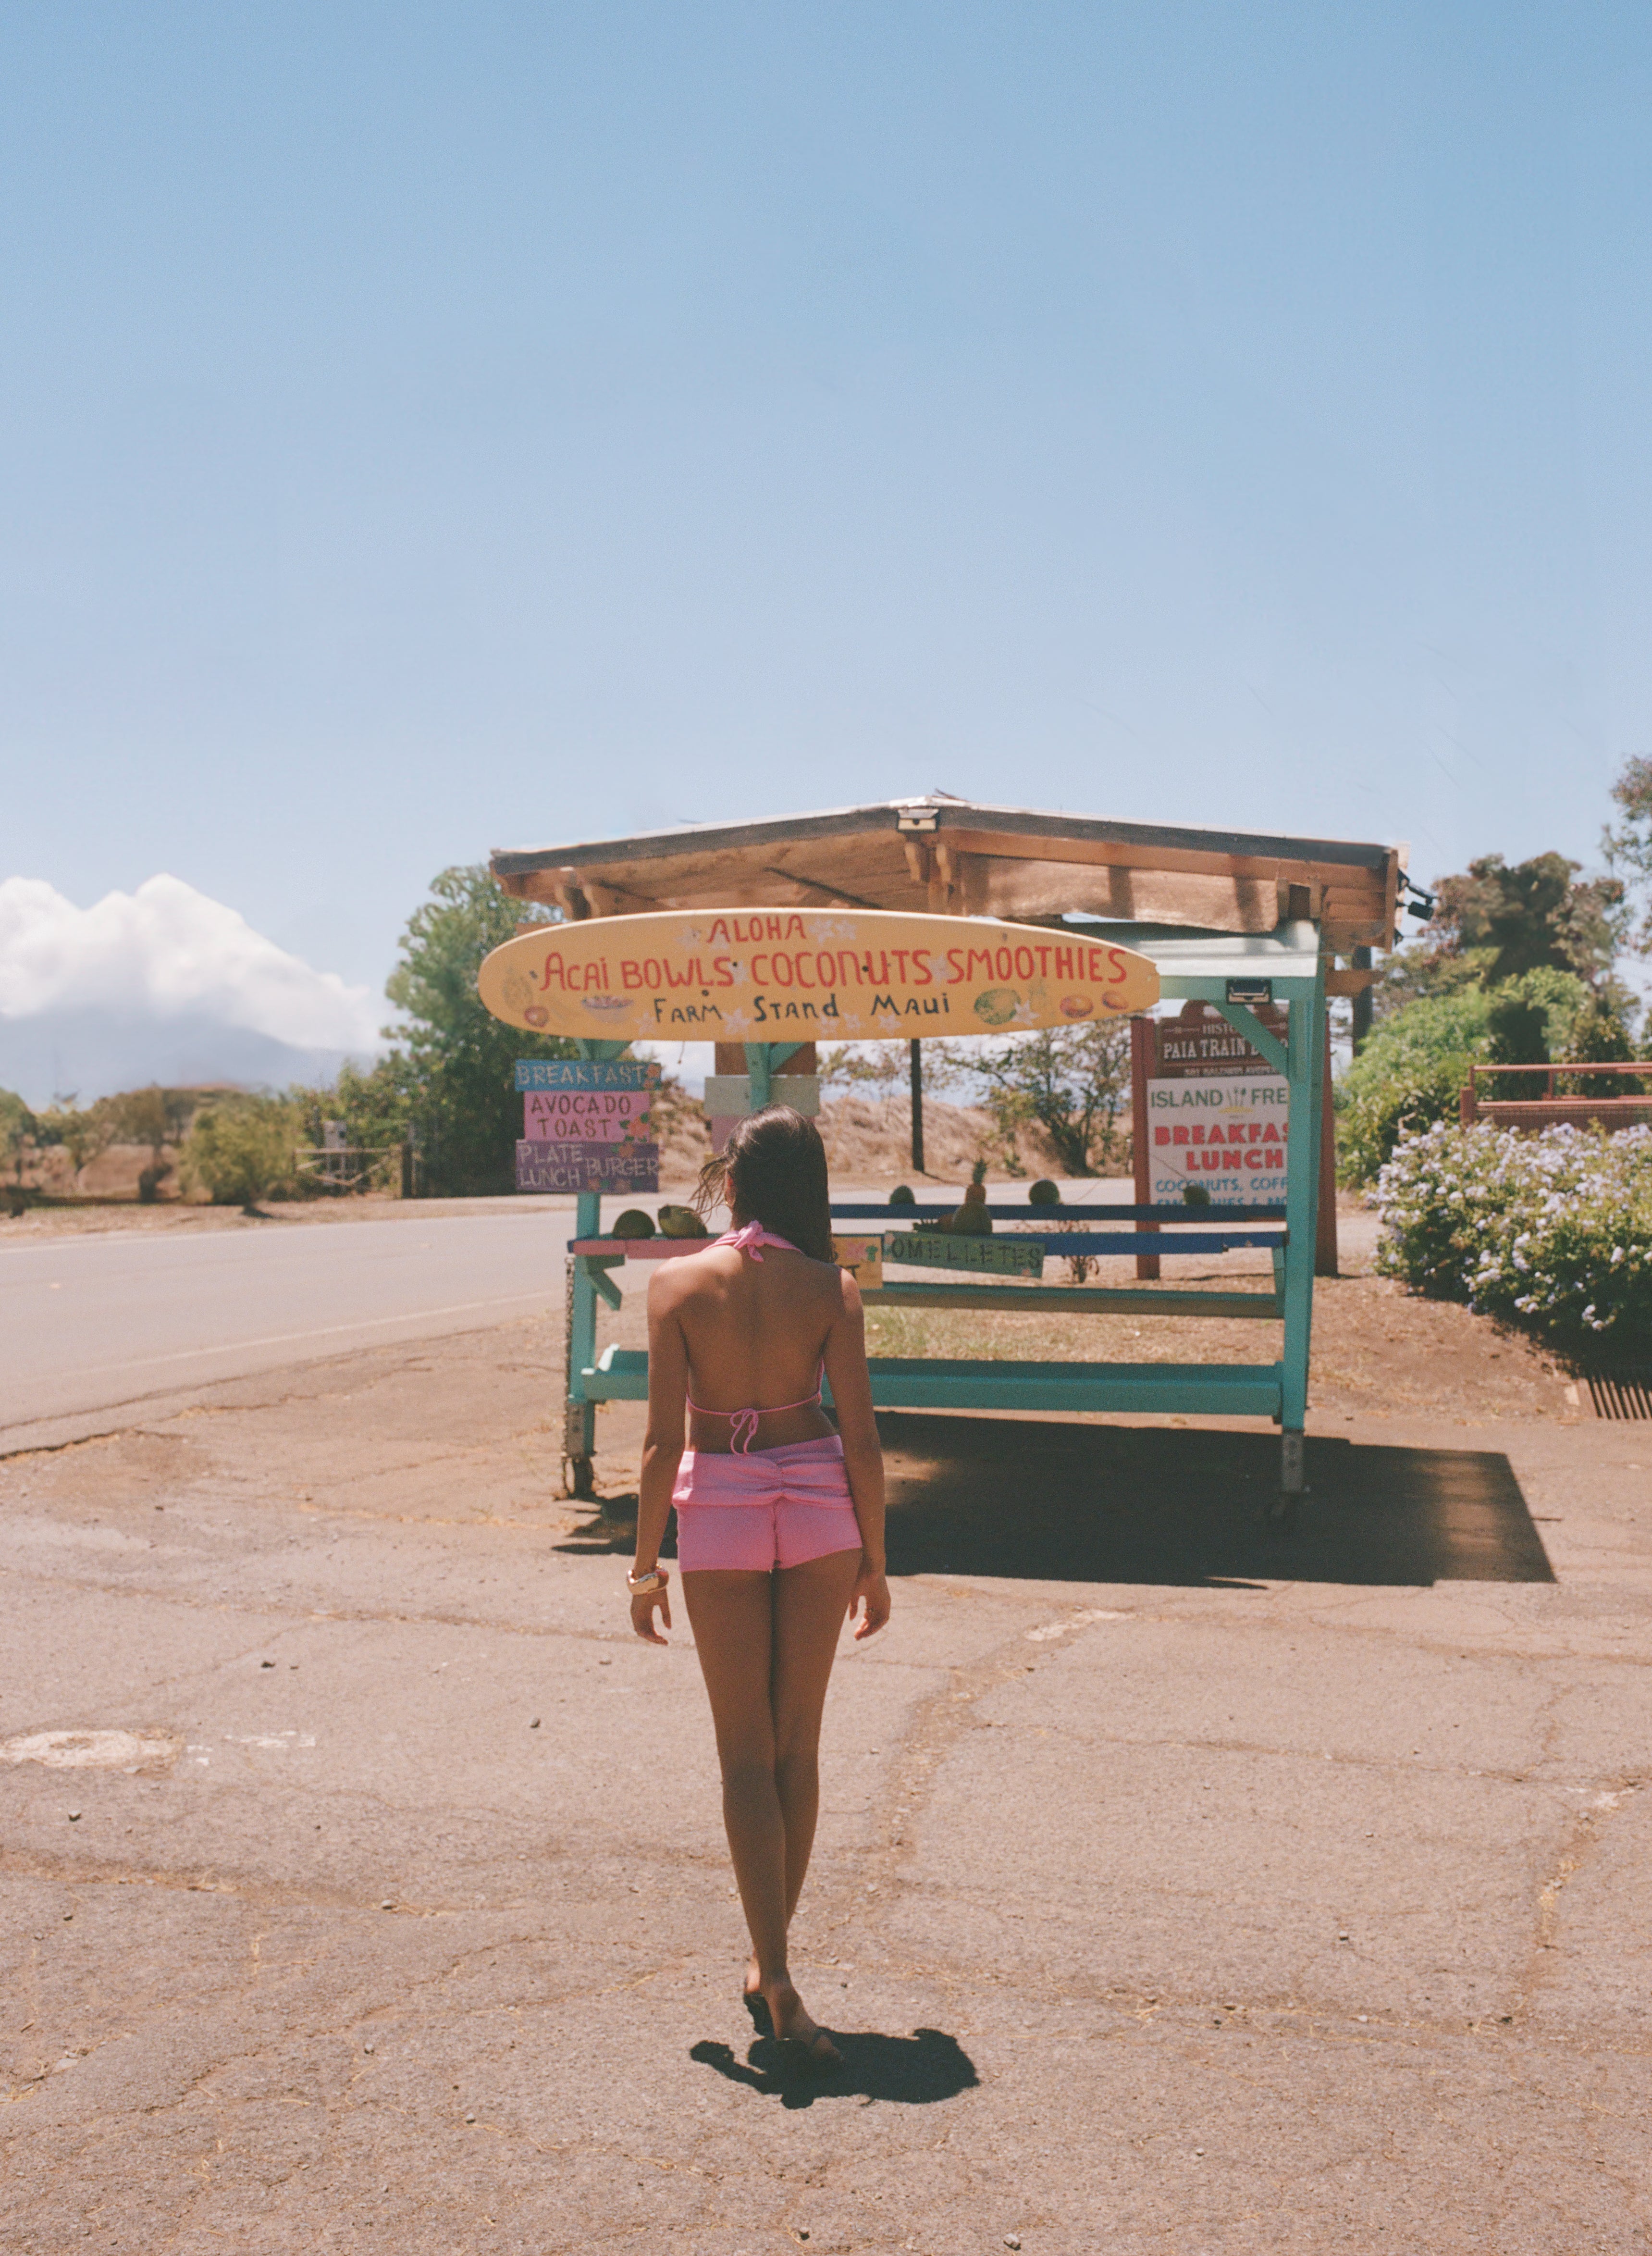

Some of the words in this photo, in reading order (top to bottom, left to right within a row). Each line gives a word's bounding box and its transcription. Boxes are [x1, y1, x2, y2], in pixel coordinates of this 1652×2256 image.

[707, 915, 807, 942] ALOHA
[621, 957, 734, 990] BOWLS
[751, 949, 933, 988] COCONUTS
[947, 946, 1127, 985] SMOOTHIES
[1163, 1041, 1197, 1059] PAIA
[1200, 1037, 1246, 1057] TRAIN
[516, 1065, 644, 1085] BREAKFAST
[531, 1094, 631, 1115] AVOCADO
[1151, 1089, 1223, 1107] ISLAND
[536, 1118, 610, 1138] TOAST
[517, 1144, 583, 1164] PLATE
[1186, 1149, 1283, 1171] LUNCH
[586, 1157, 660, 1177] BURGER
[520, 1168, 580, 1187] LUNCH
[892, 1239, 1042, 1269] OMELLETES
